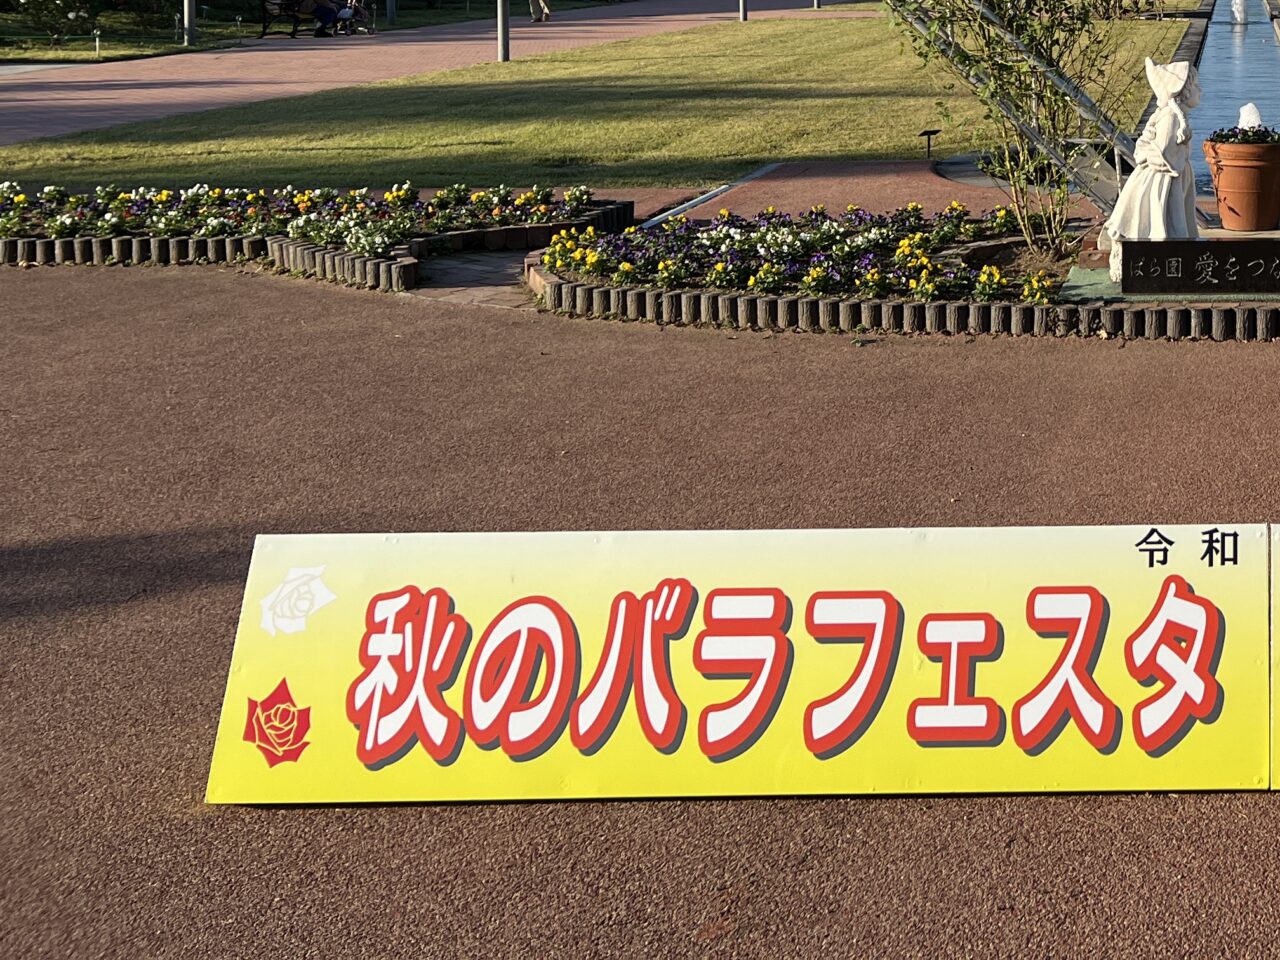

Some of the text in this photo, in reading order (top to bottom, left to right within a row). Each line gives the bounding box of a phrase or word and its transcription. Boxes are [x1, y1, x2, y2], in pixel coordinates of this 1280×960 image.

[346, 576, 1222, 766] 秋のバラフェスタ
